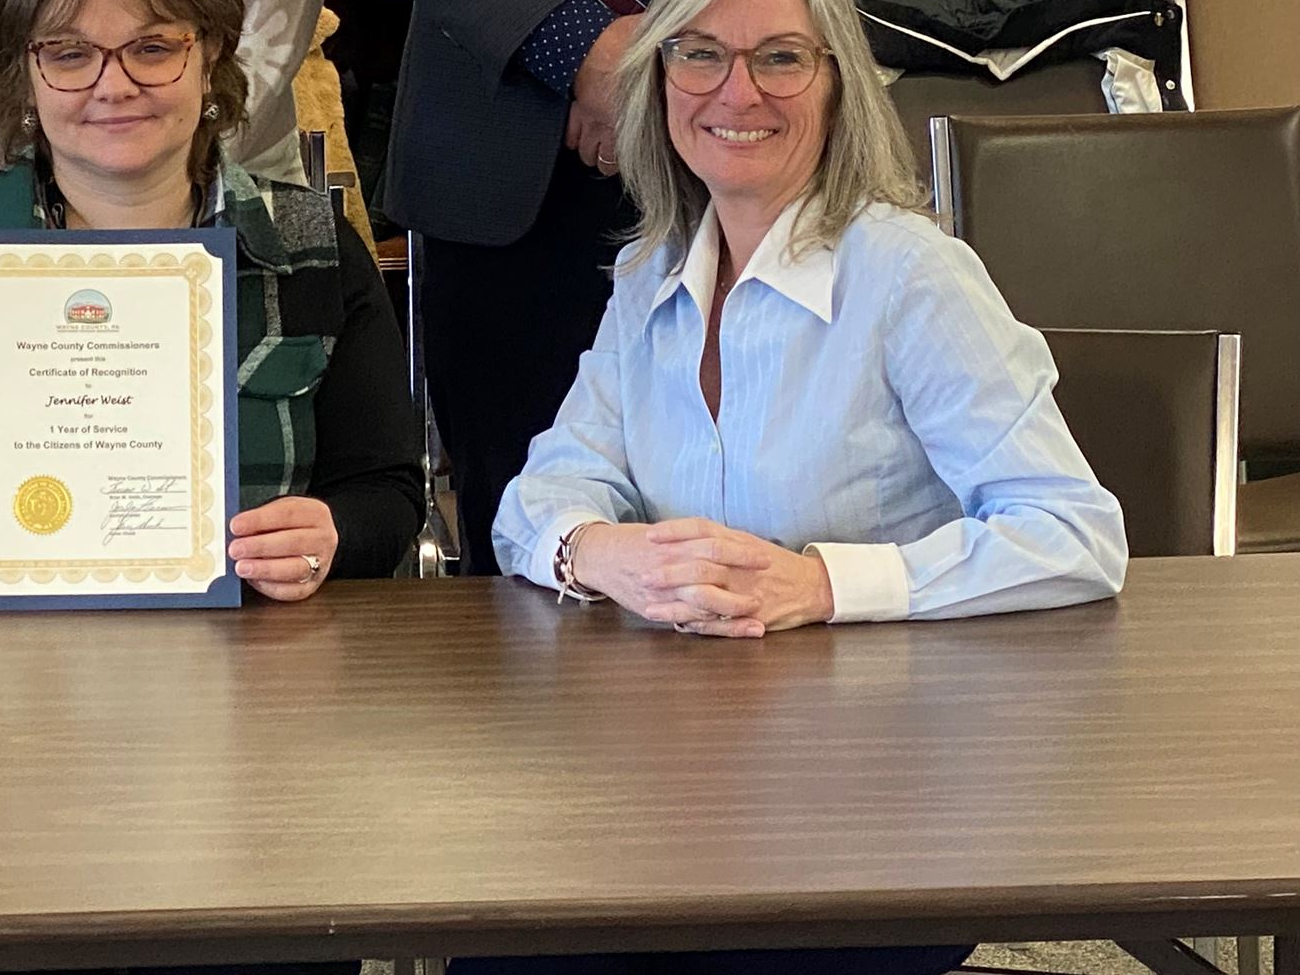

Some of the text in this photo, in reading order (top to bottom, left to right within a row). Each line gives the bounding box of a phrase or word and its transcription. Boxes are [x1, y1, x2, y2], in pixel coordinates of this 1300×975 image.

[16, 341, 160, 352] Wayne County Commissioners
[29, 368, 148, 379] Certificate of Recognition
[45, 394, 134, 407] Jennifer Weist
[50, 425, 128, 433] 1 Year of Service
[14, 440, 163, 450] to the Citizens of Wayne County
